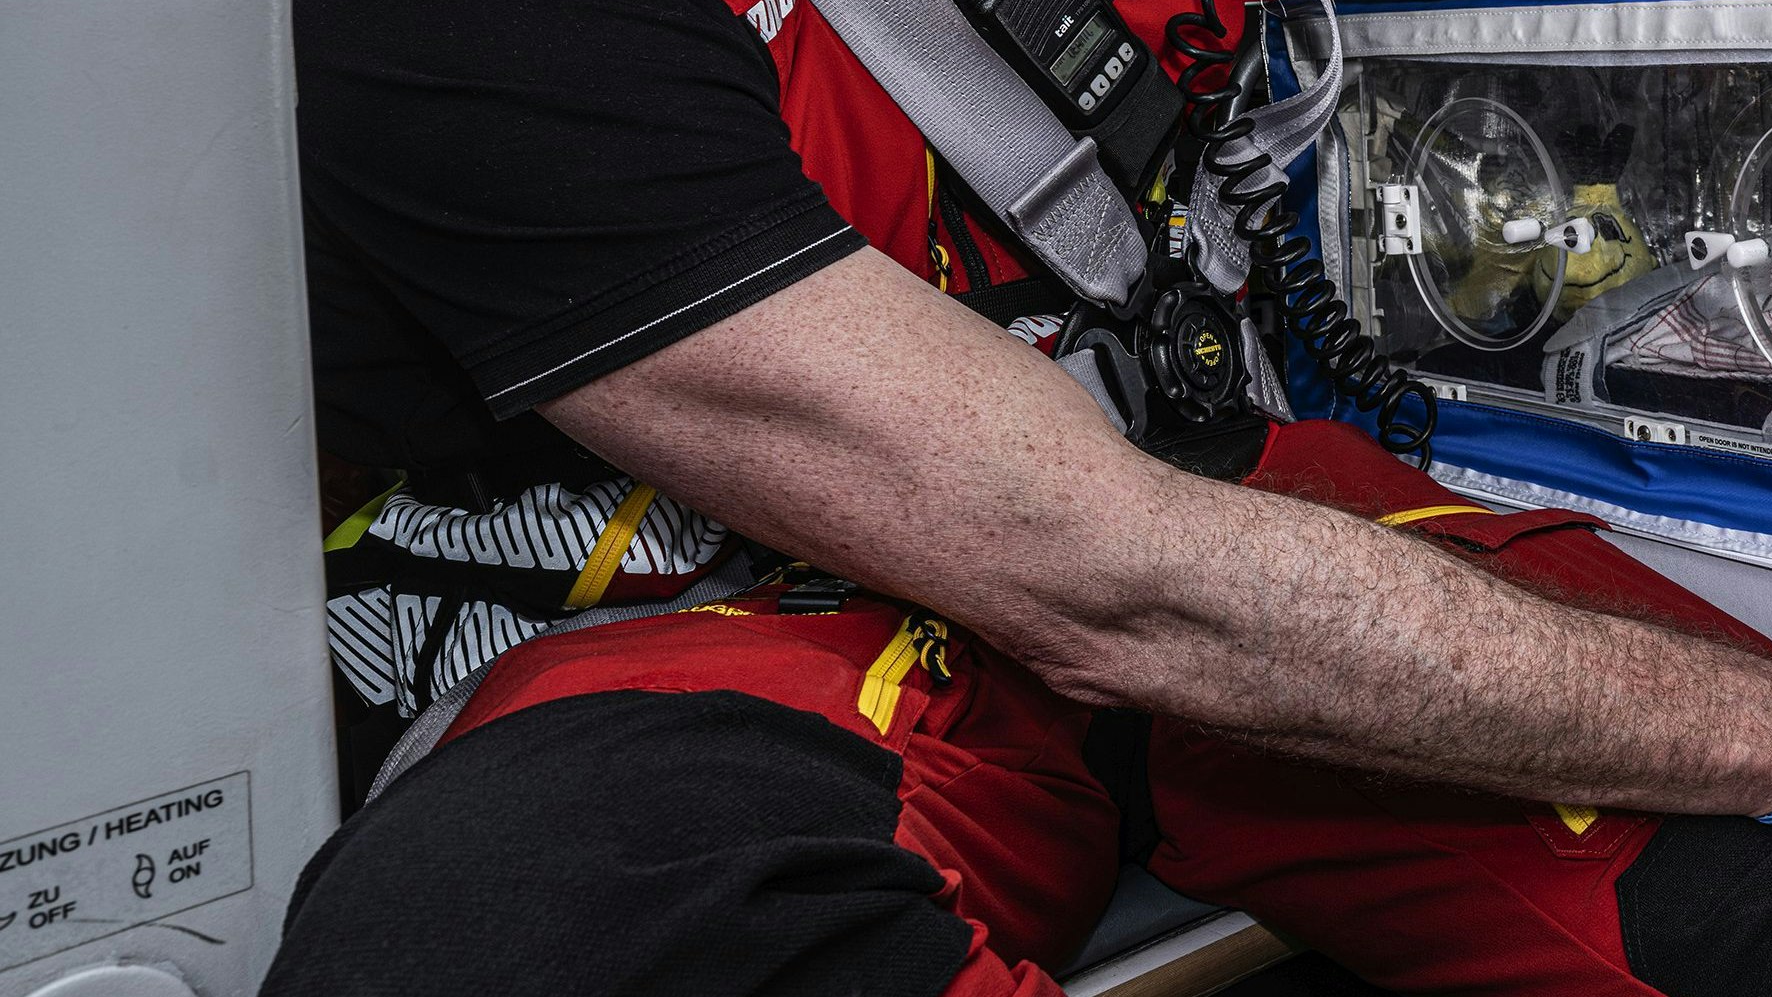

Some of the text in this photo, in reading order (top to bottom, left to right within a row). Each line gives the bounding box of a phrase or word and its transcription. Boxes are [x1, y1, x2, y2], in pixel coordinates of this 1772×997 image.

[1055, 15, 1074, 37] tait
[1699, 435, 1714, 444] OPEN
[1715, 438, 1731, 447] DOOR
[1738, 442, 1750, 451] NOT
[0, 789, 224, 873] ZUNG / HEATING
[168, 839, 211, 865] AUF
[169, 863, 201, 884] ON
[28, 886, 60, 910] ZU
[29, 901, 77, 930] OFF
